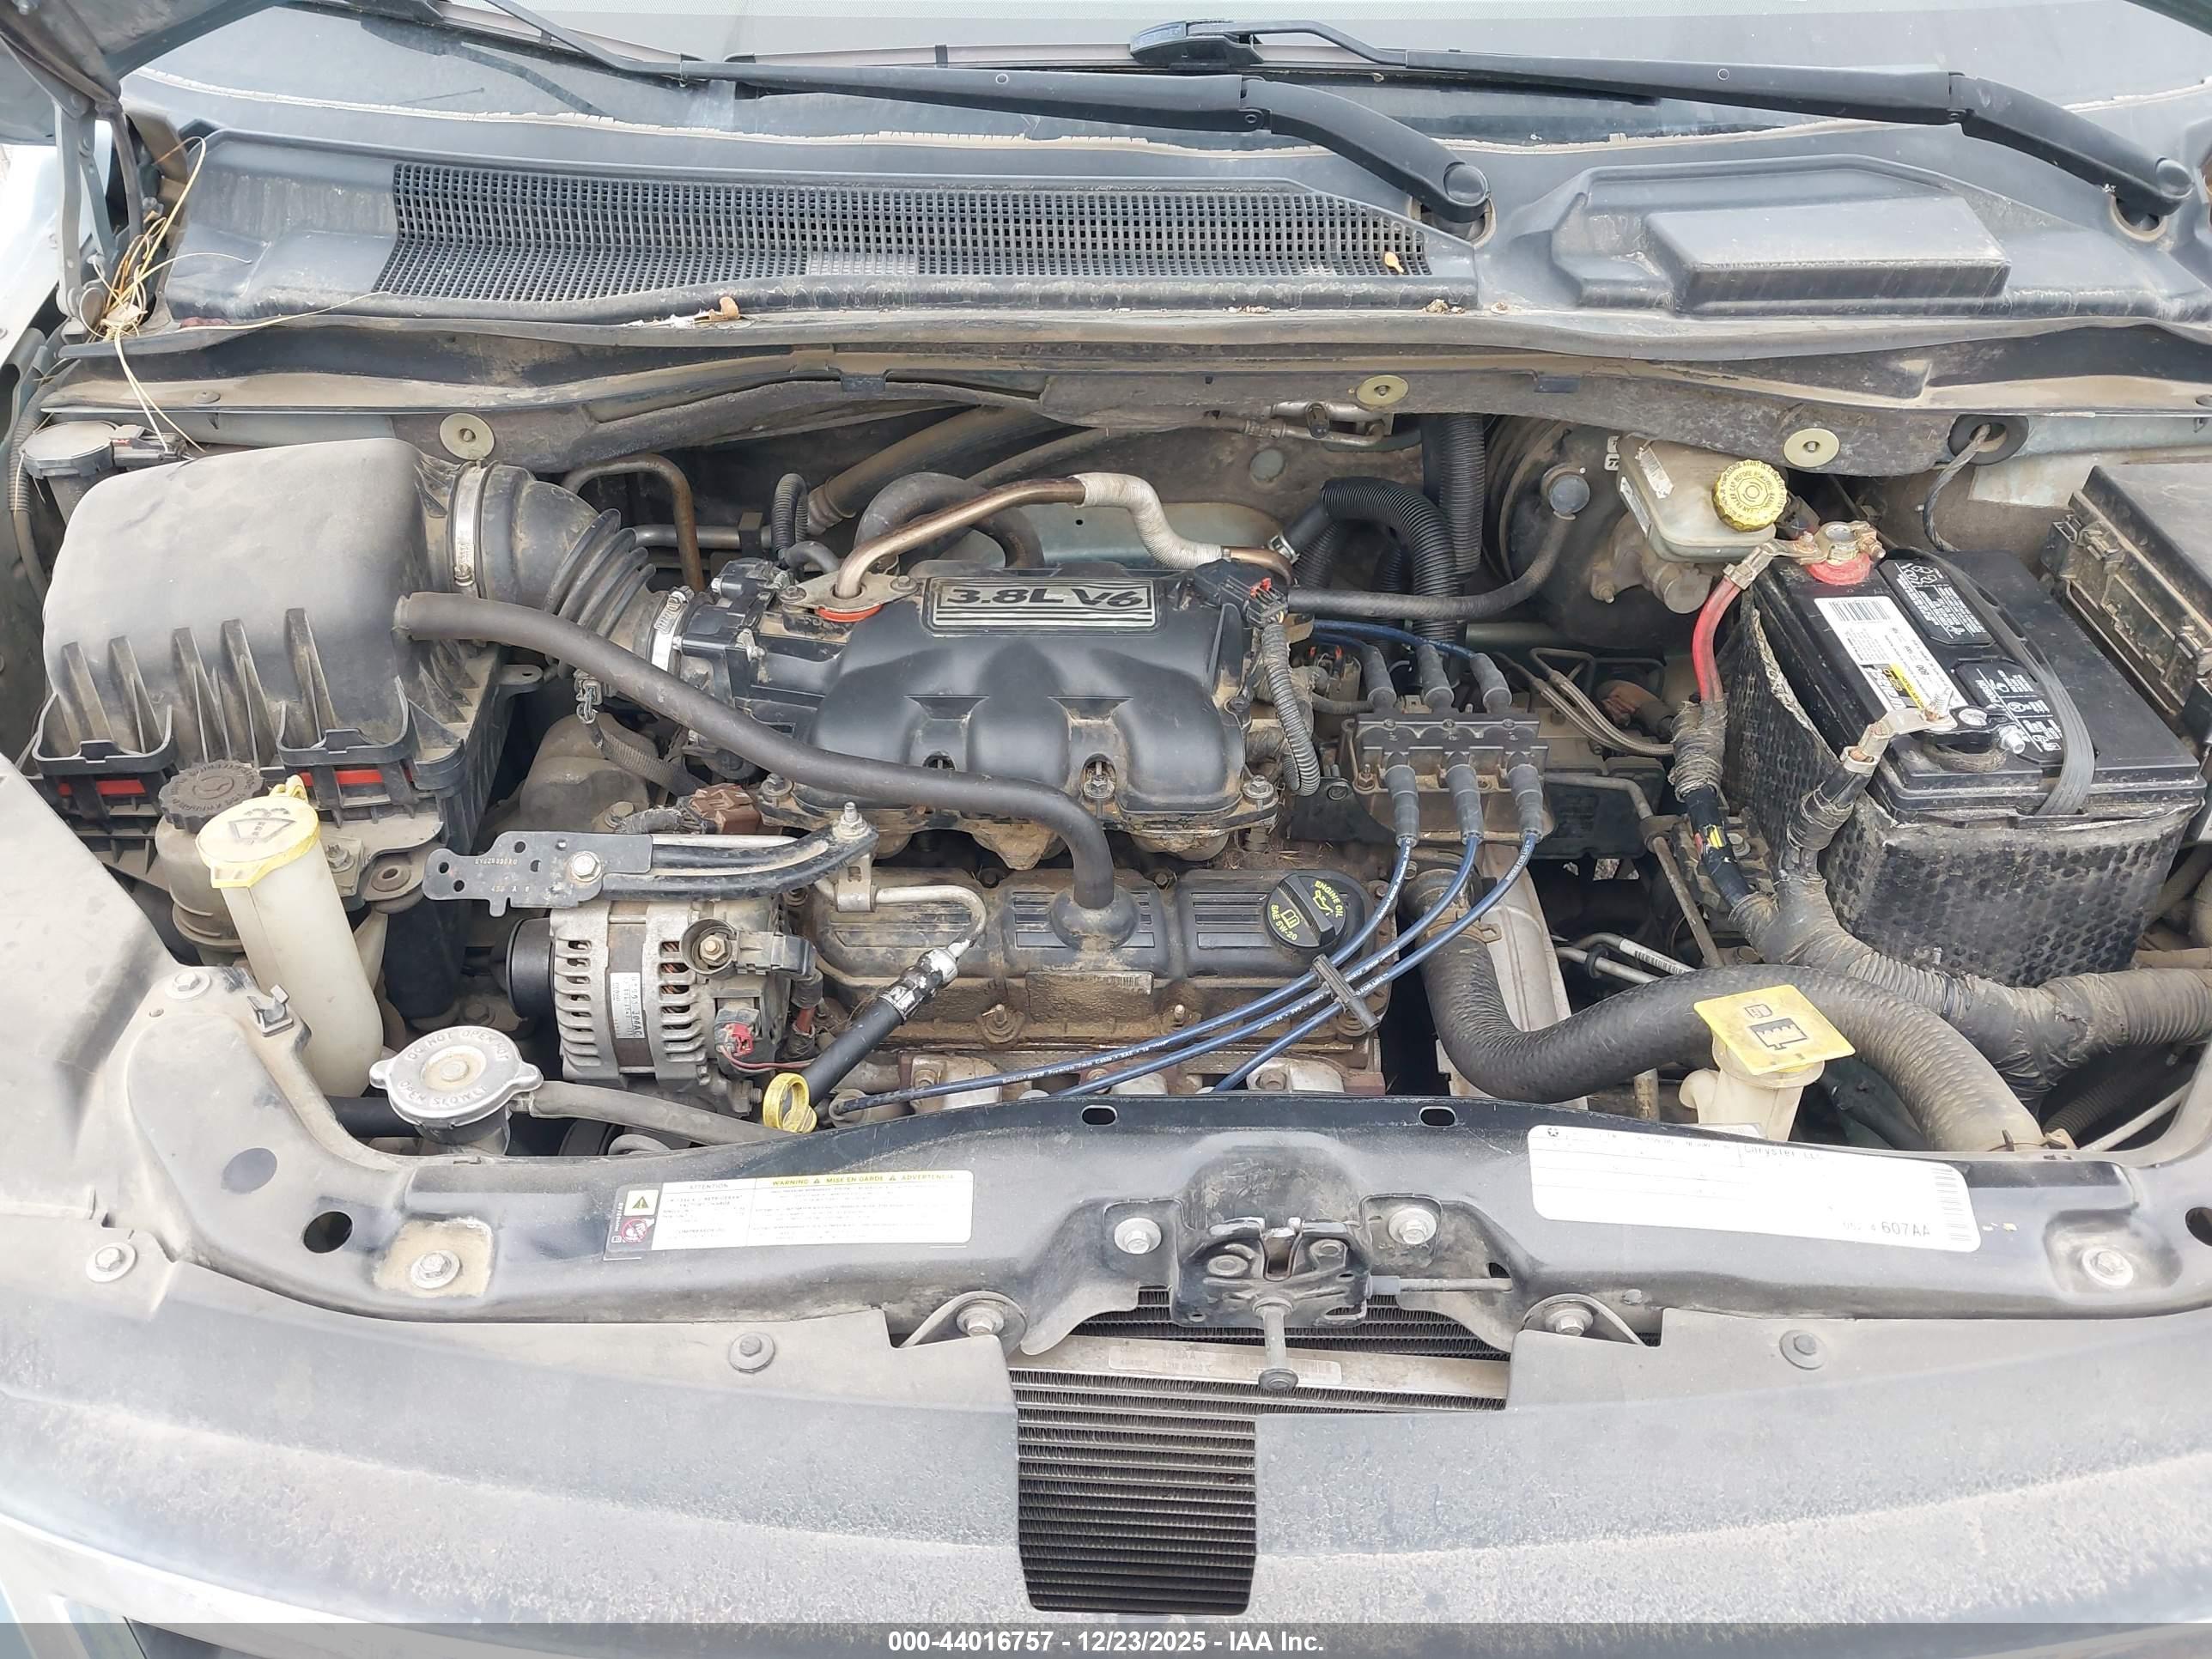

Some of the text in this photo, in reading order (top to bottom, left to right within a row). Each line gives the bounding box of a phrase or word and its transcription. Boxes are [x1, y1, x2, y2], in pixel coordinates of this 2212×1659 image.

[946, 588, 1144, 607] 3.8L V6
[1314, 880, 1341, 904] ENGINE
[1271, 904, 1280, 920] SAE
[1334, 905, 1344, 918] OIL
[427, 1032, 454, 1048] NOT
[460, 1030, 497, 1044] OPEN
[495, 1041, 510, 1061] HOT
[398, 1079, 487, 1107] OPEN SLOWLY
